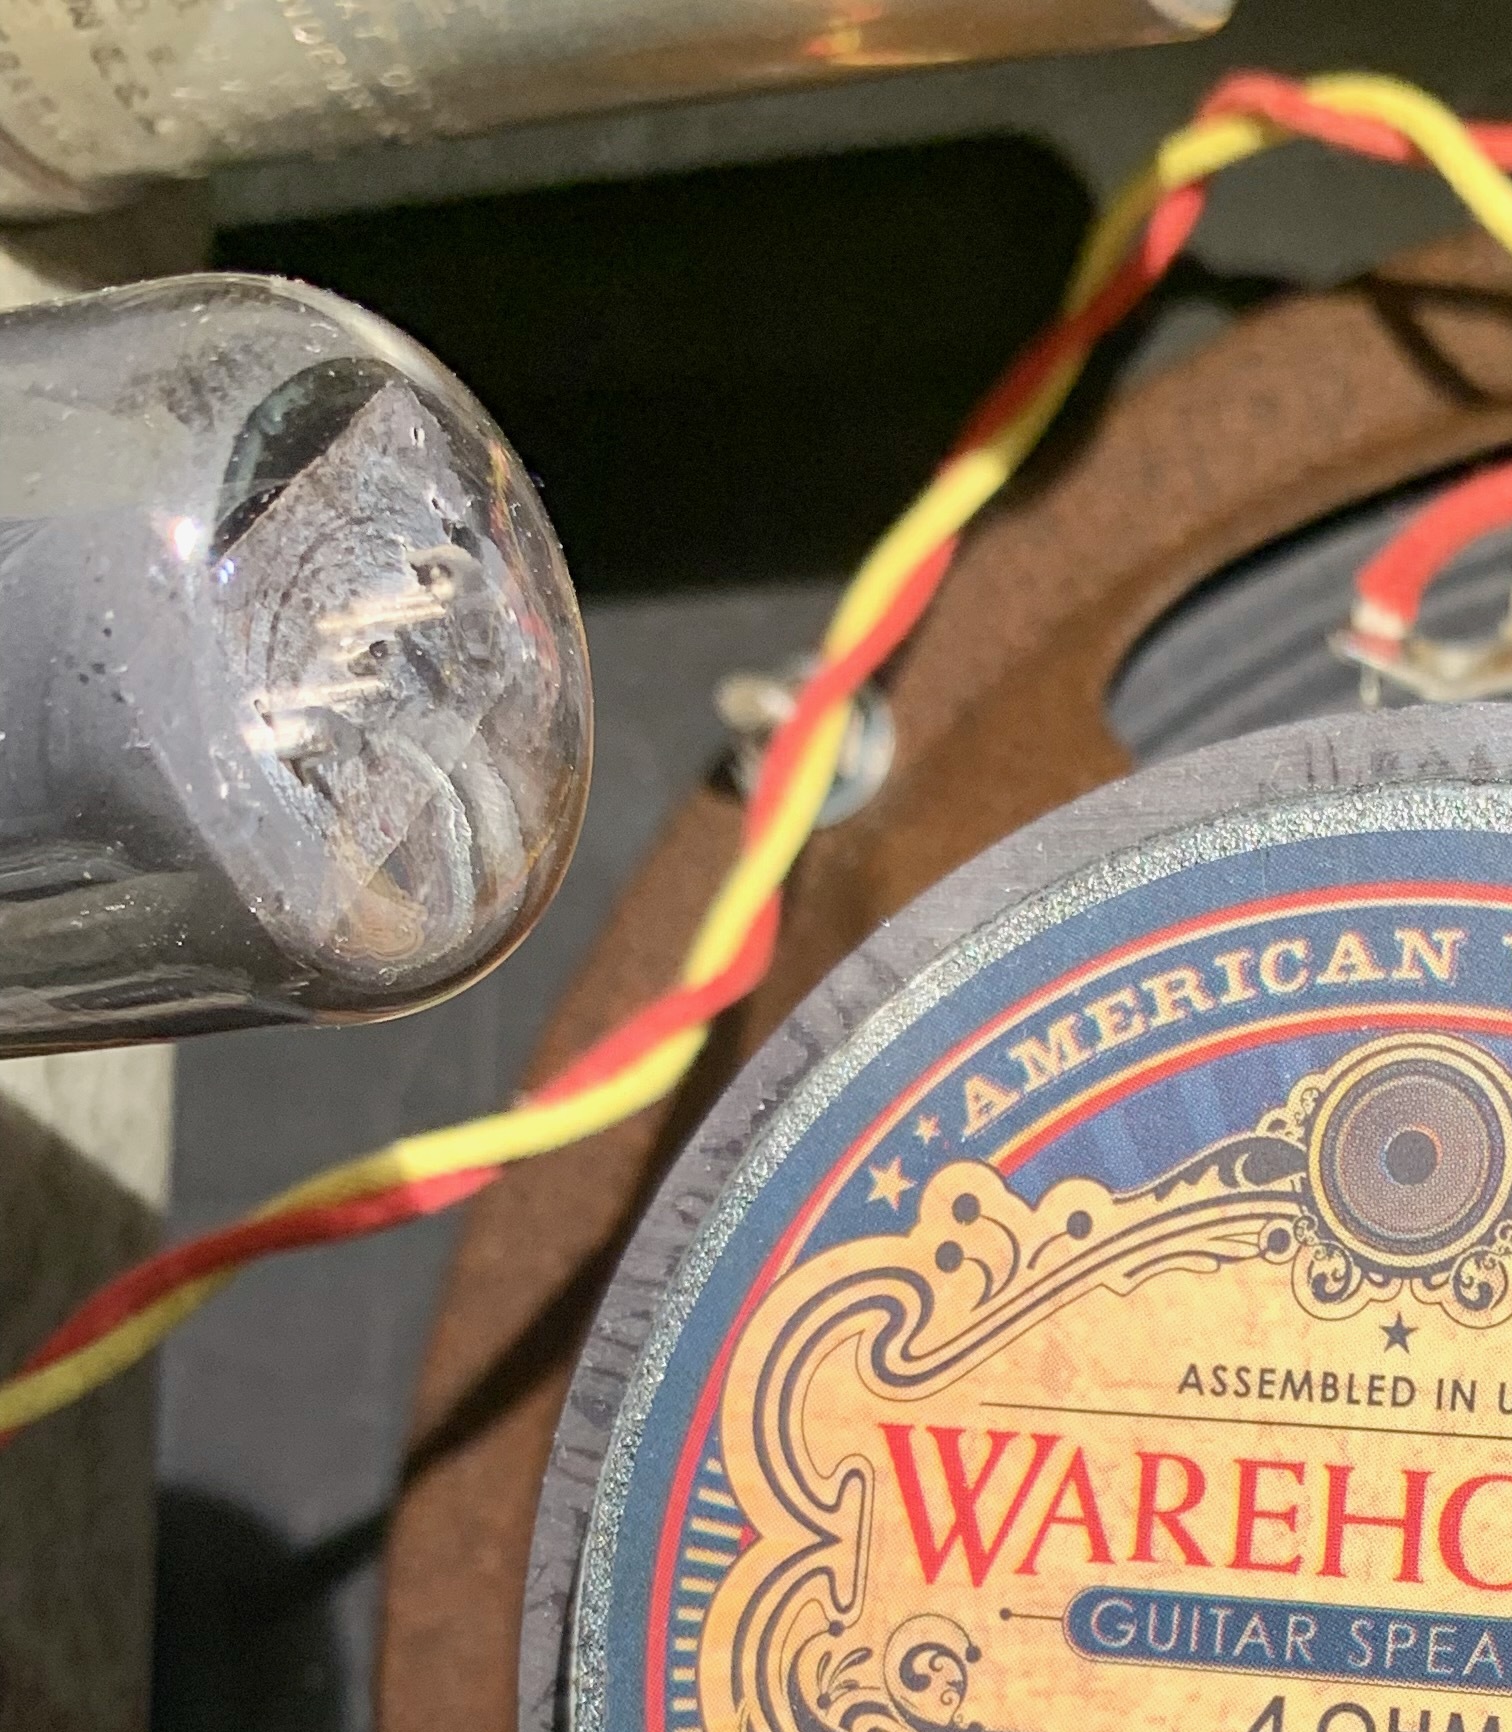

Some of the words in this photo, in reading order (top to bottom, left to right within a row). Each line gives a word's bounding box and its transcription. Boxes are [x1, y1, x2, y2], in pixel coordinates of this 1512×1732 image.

[960, 927, 1467, 1140] AMERICAN
[1177, 1362, 1416, 1407] ASSEMBLED
[1435, 1377, 1477, 1413] IN
[1090, 1598, 1318, 1664] GUITAR
